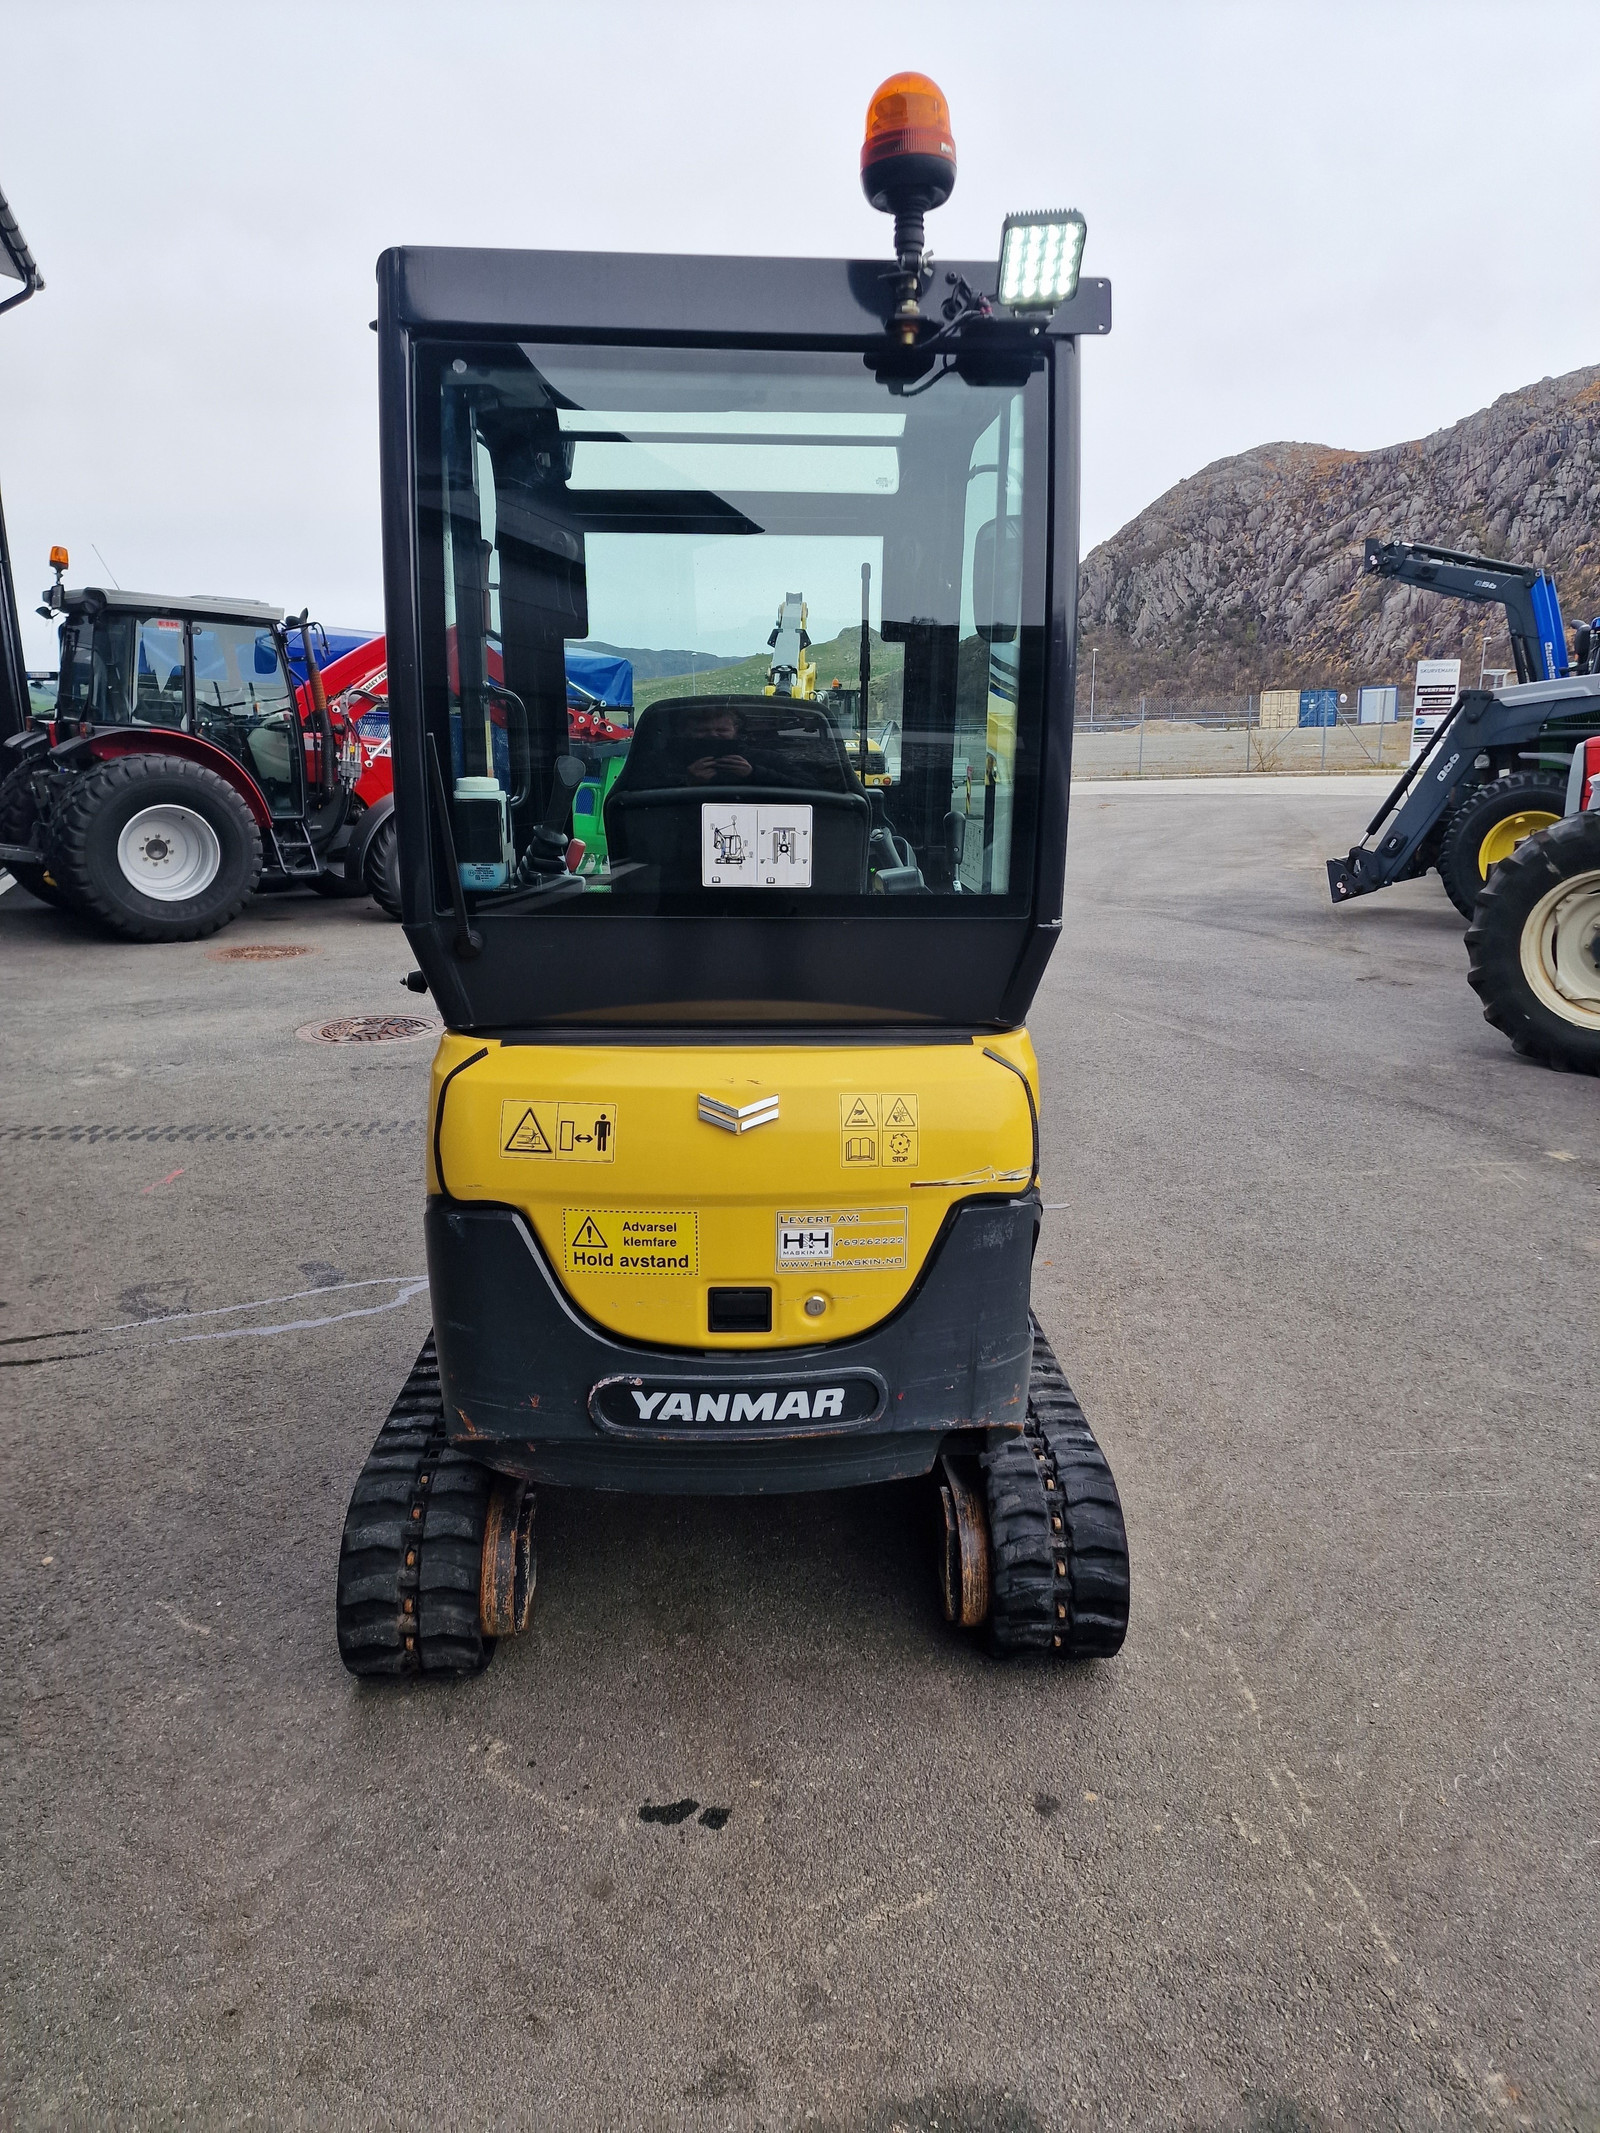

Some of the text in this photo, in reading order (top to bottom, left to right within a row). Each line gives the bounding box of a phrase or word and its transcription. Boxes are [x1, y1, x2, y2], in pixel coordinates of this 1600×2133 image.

[780, 1216, 831, 1224] LEVERT
[622, 1221, 677, 1233] Advarsel
[623, 1236, 677, 1248] klemfare
[843, 1237, 903, 1246] 69262222
[573, 1251, 689, 1269] Hold avstand
[780, 1257, 902, 1268] WWW.HH-MASKIN.NO
[631, 1387, 845, 1422] YANMAR
